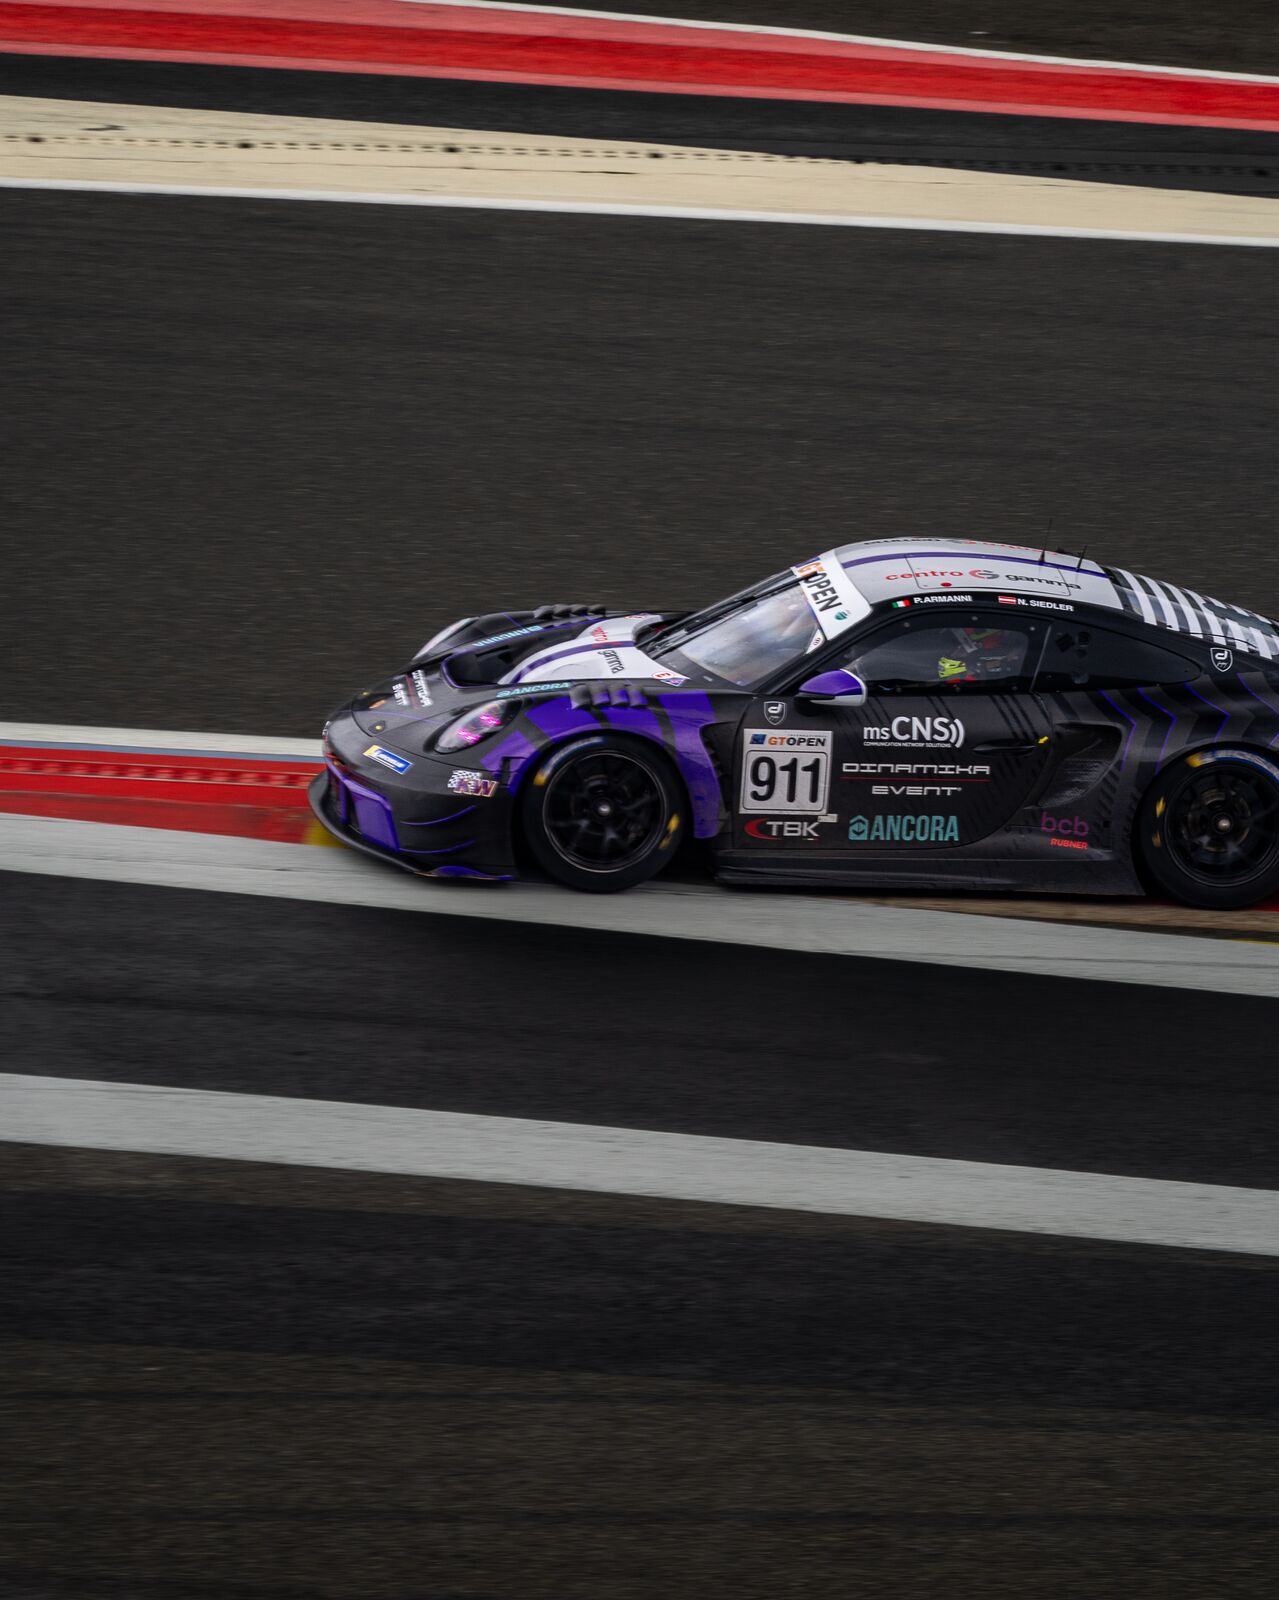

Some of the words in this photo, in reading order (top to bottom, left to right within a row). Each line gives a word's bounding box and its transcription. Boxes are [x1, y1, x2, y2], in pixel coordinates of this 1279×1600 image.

[885, 570, 963, 581] centro
[1006, 573, 1081, 590] gamma
[1017, 598, 1029, 606] N.
[1029, 599, 1074, 612] SIEDLER
[509, 682, 572, 695] ANCORA
[842, 763, 991, 775] DINAMIKA
[750, 756, 821, 804] 911
[766, 821, 820, 837] TBK
[870, 815, 960, 842] ANCORA
[1040, 811, 1089, 838] bcb
[1050, 838, 1089, 850] RUBNER
